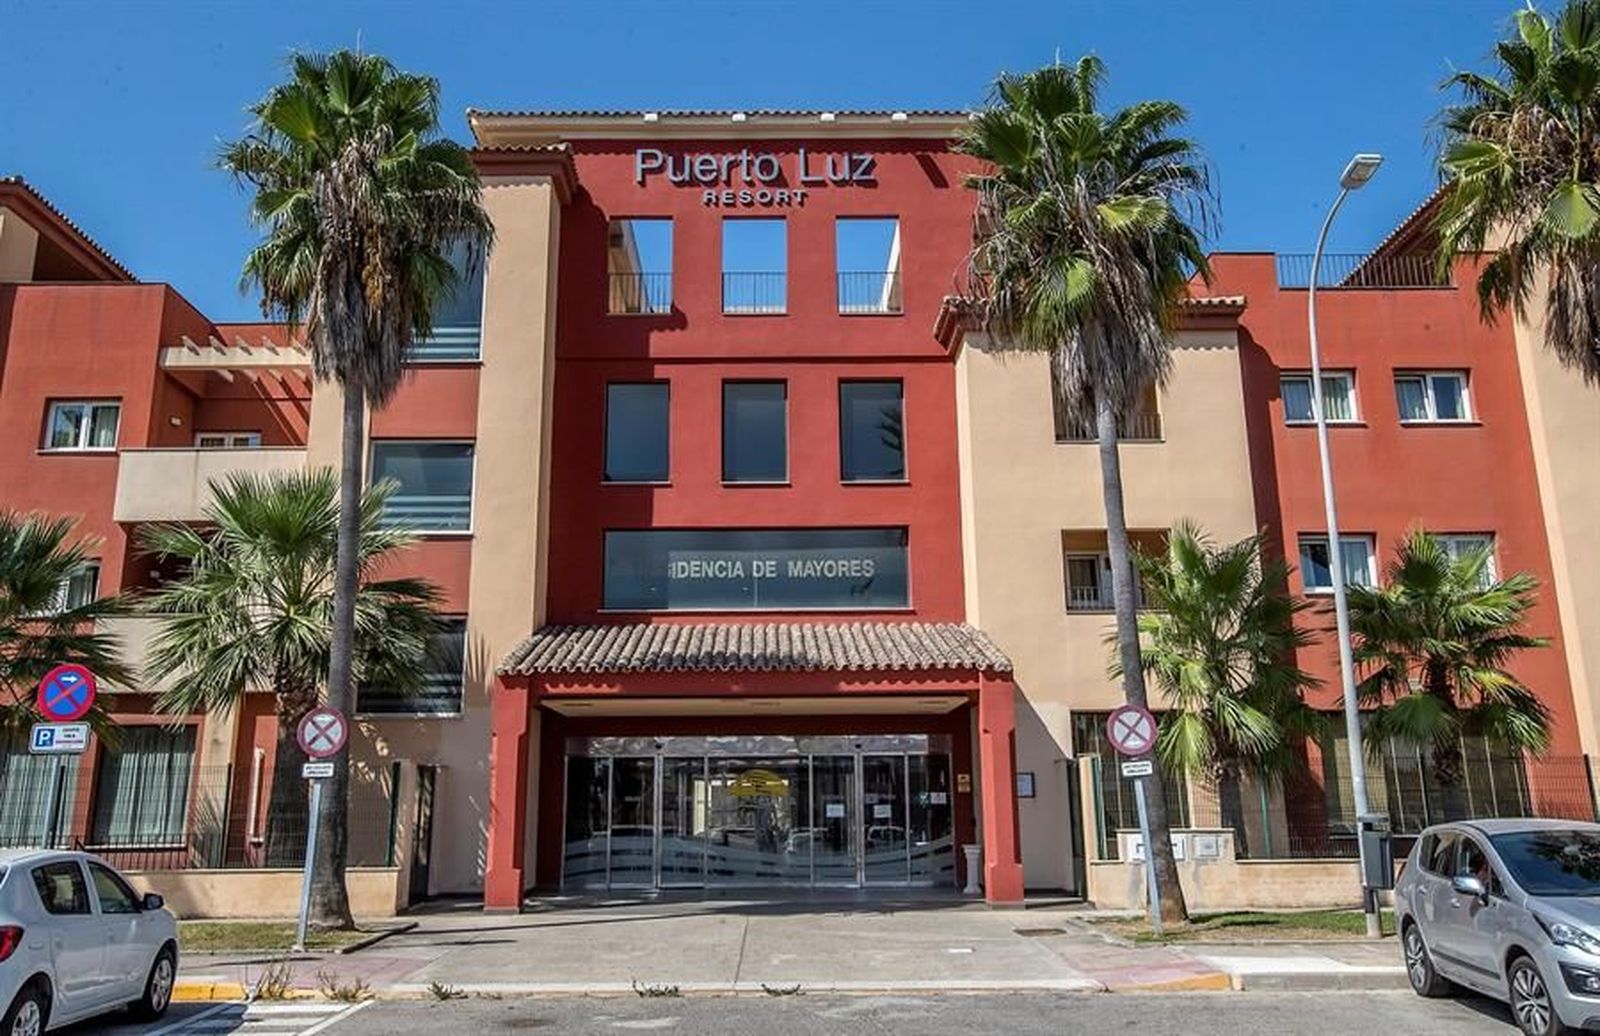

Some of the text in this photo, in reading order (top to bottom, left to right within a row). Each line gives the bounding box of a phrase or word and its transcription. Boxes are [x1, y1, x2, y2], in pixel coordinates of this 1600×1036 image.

[635, 148, 875, 182] Puerto Luz
[703, 189, 808, 203] RESORT
[752, 560, 777, 578] DE
[787, 559, 875, 578] MAYORES
